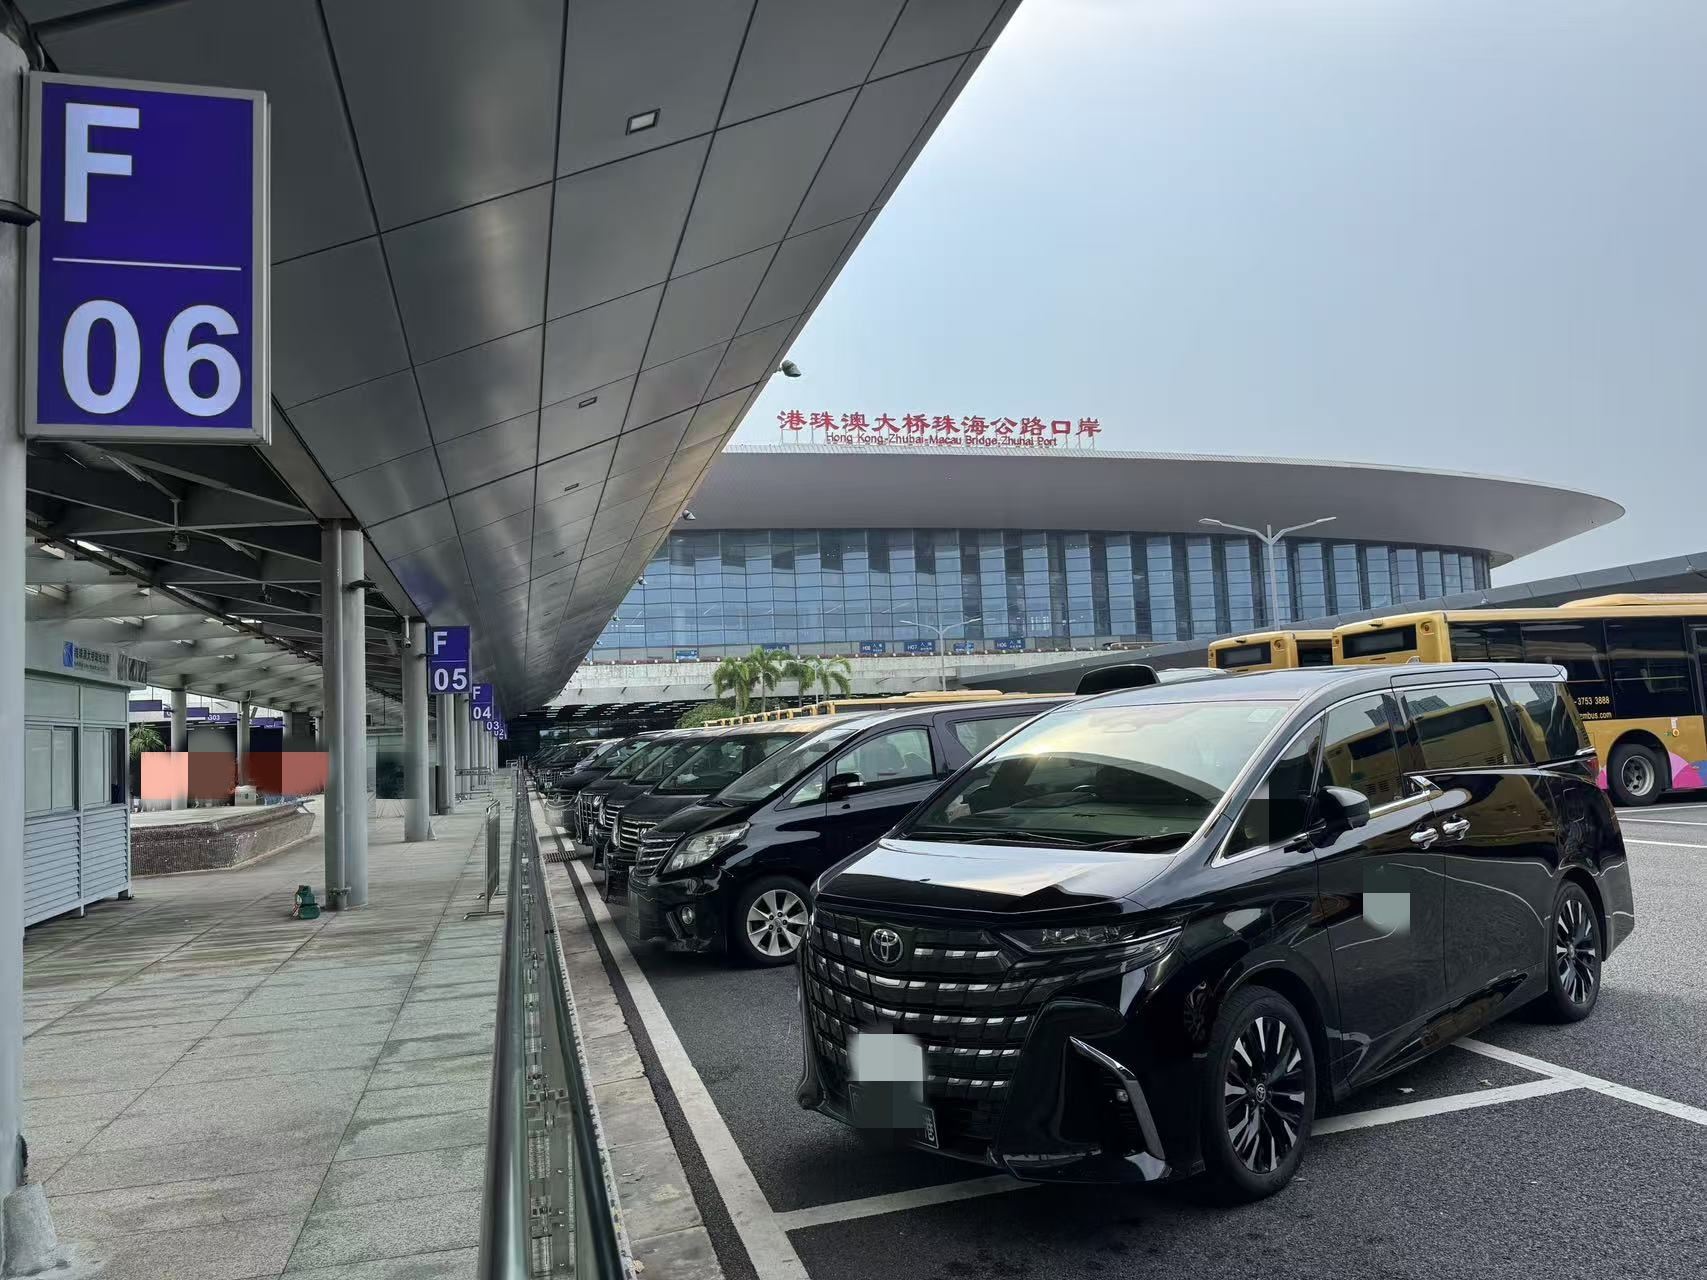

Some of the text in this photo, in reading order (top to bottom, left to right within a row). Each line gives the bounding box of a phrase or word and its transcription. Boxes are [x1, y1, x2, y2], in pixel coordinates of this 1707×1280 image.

[64, 103, 140, 222] F
[62, 299, 241, 417] 06
[777, 410, 1102, 437] 港珠澳大桥珠海公路口岸
[826, 432, 853, 444] Hong
[1038, 437, 1057, 446] Port
[433, 631, 447, 655] F
[434, 668, 467, 691] 05
[473, 686, 481, 700] F
[473, 706, 491, 720] 04
[486, 720, 500, 731] 03
